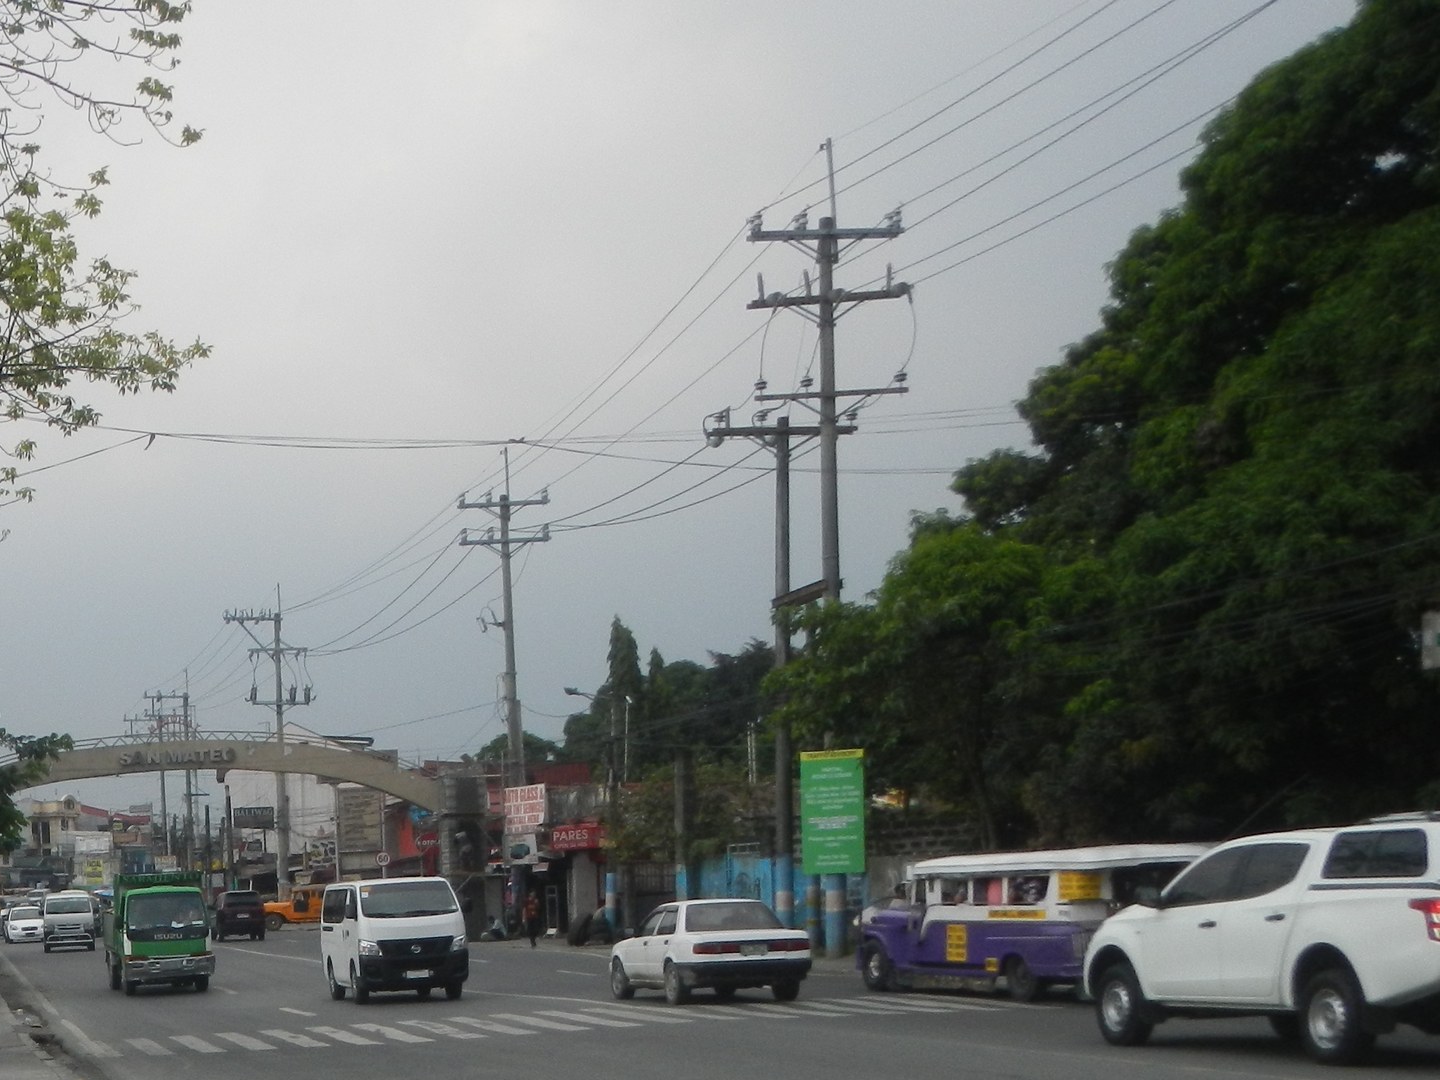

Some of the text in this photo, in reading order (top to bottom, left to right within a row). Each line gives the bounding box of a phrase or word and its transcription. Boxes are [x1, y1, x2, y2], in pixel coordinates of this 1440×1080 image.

[120, 747, 235, 766] SAN MATEO
[553, 829, 588, 842] PARES
[378, 854, 389, 863] 60
